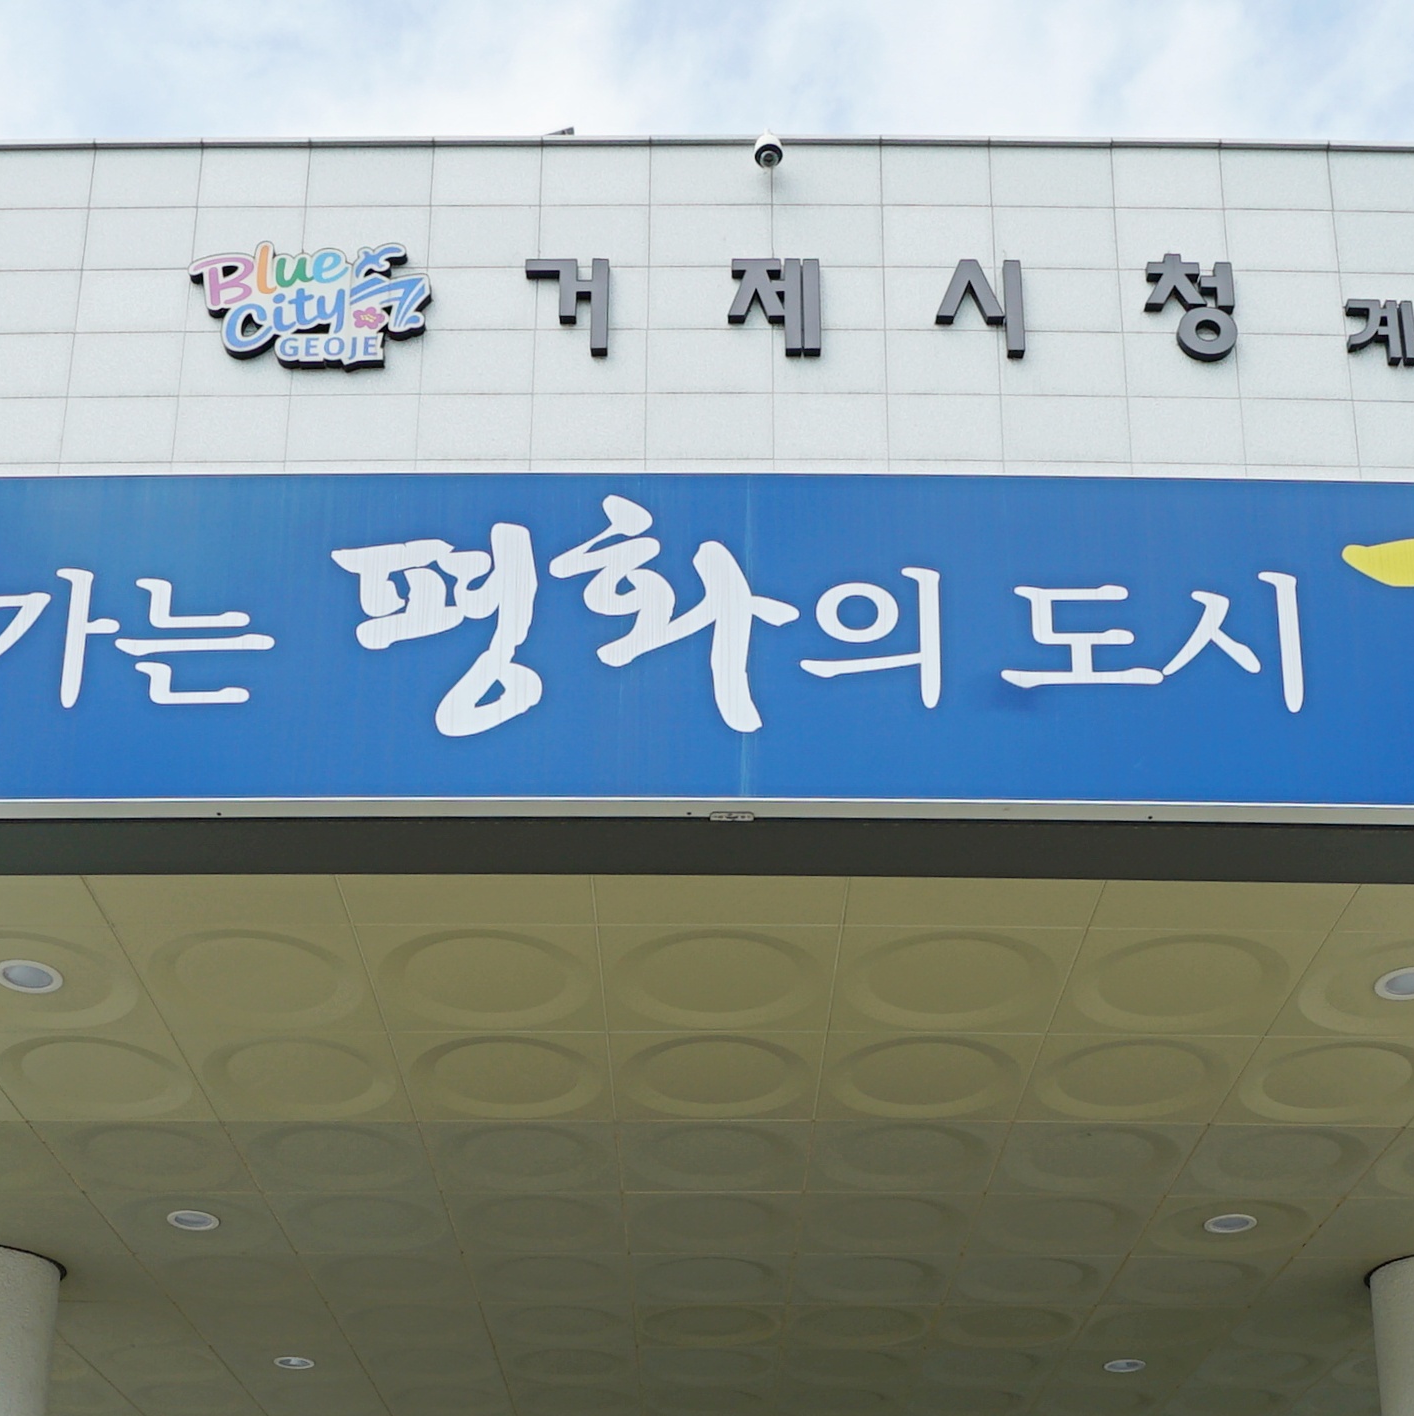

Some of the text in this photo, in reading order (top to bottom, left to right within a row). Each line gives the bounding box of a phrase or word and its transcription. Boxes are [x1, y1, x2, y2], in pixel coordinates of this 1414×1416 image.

[191, 245, 350, 306] Blue
[225, 287, 345, 349] City
[279, 336, 378, 360] GEOJE
[331, 495, 941, 737] 평화의
[1000, 571, 1304, 714] 도시
